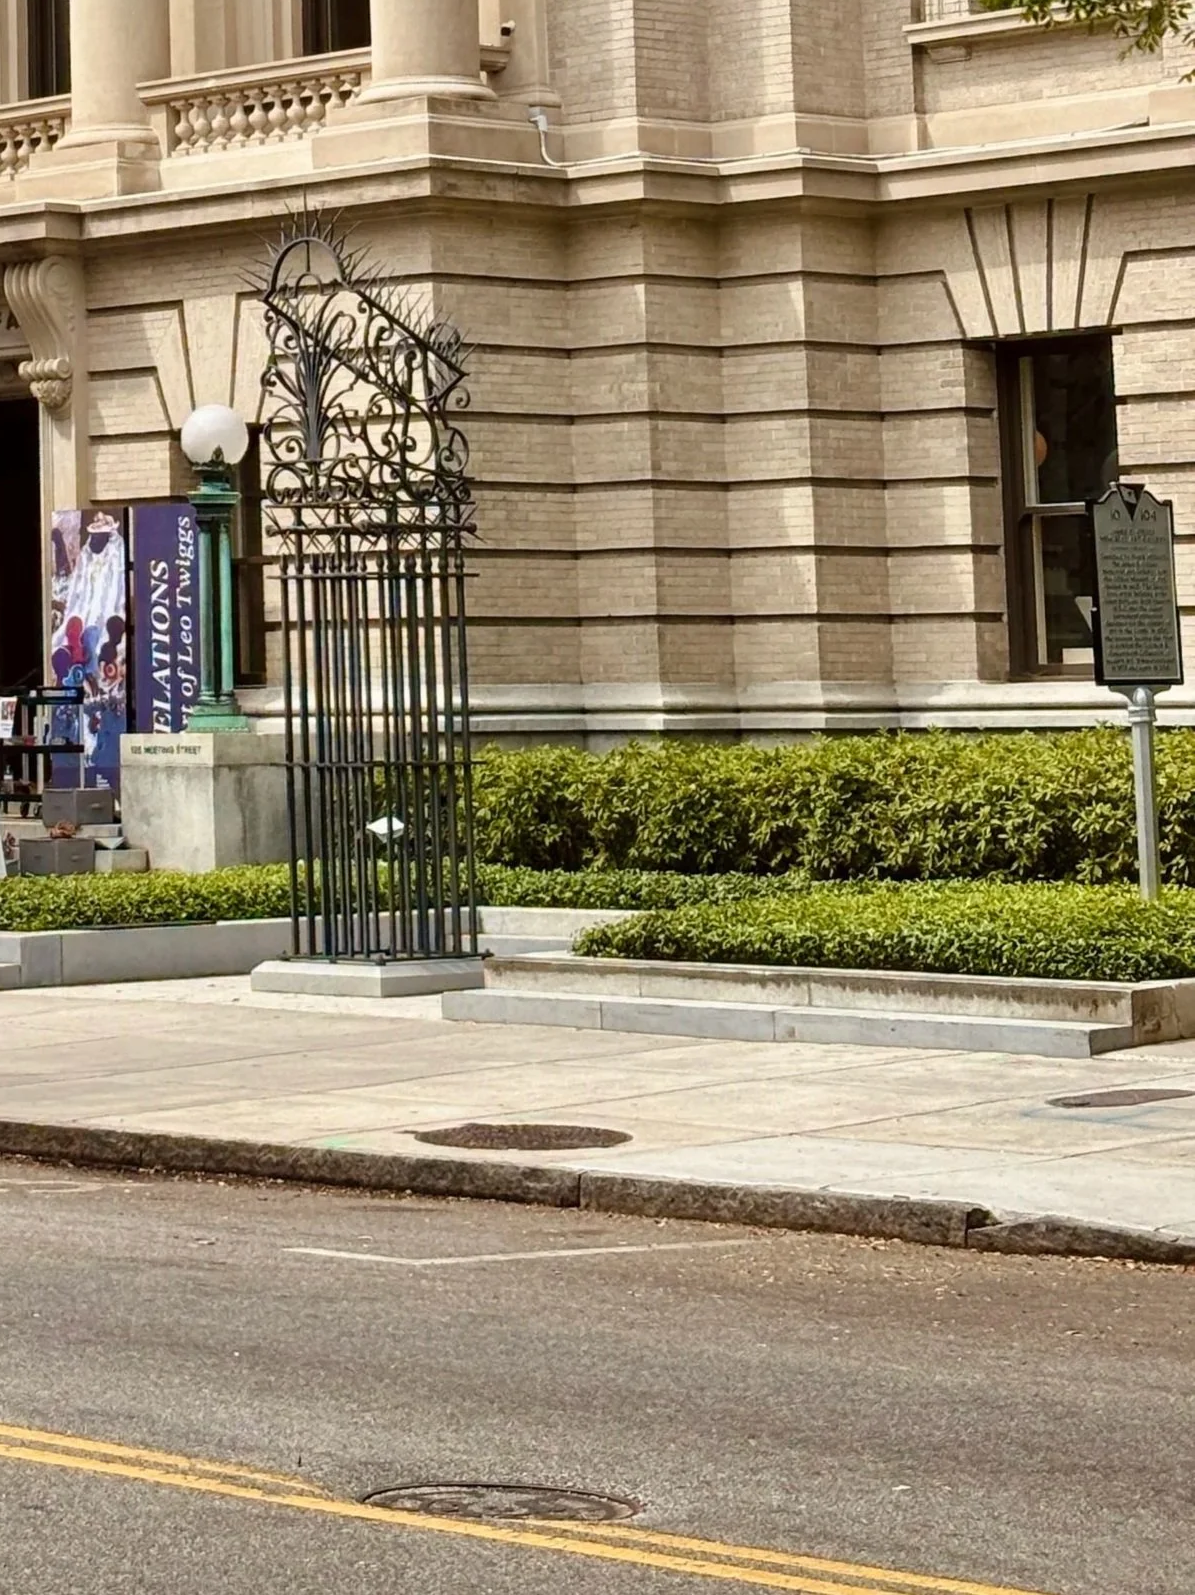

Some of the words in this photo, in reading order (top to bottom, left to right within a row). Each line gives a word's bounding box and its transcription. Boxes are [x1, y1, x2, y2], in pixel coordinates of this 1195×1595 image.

[175, 516, 195, 609] Twiggs
[177, 616, 193, 665] Leo
[177, 666, 197, 698] of
